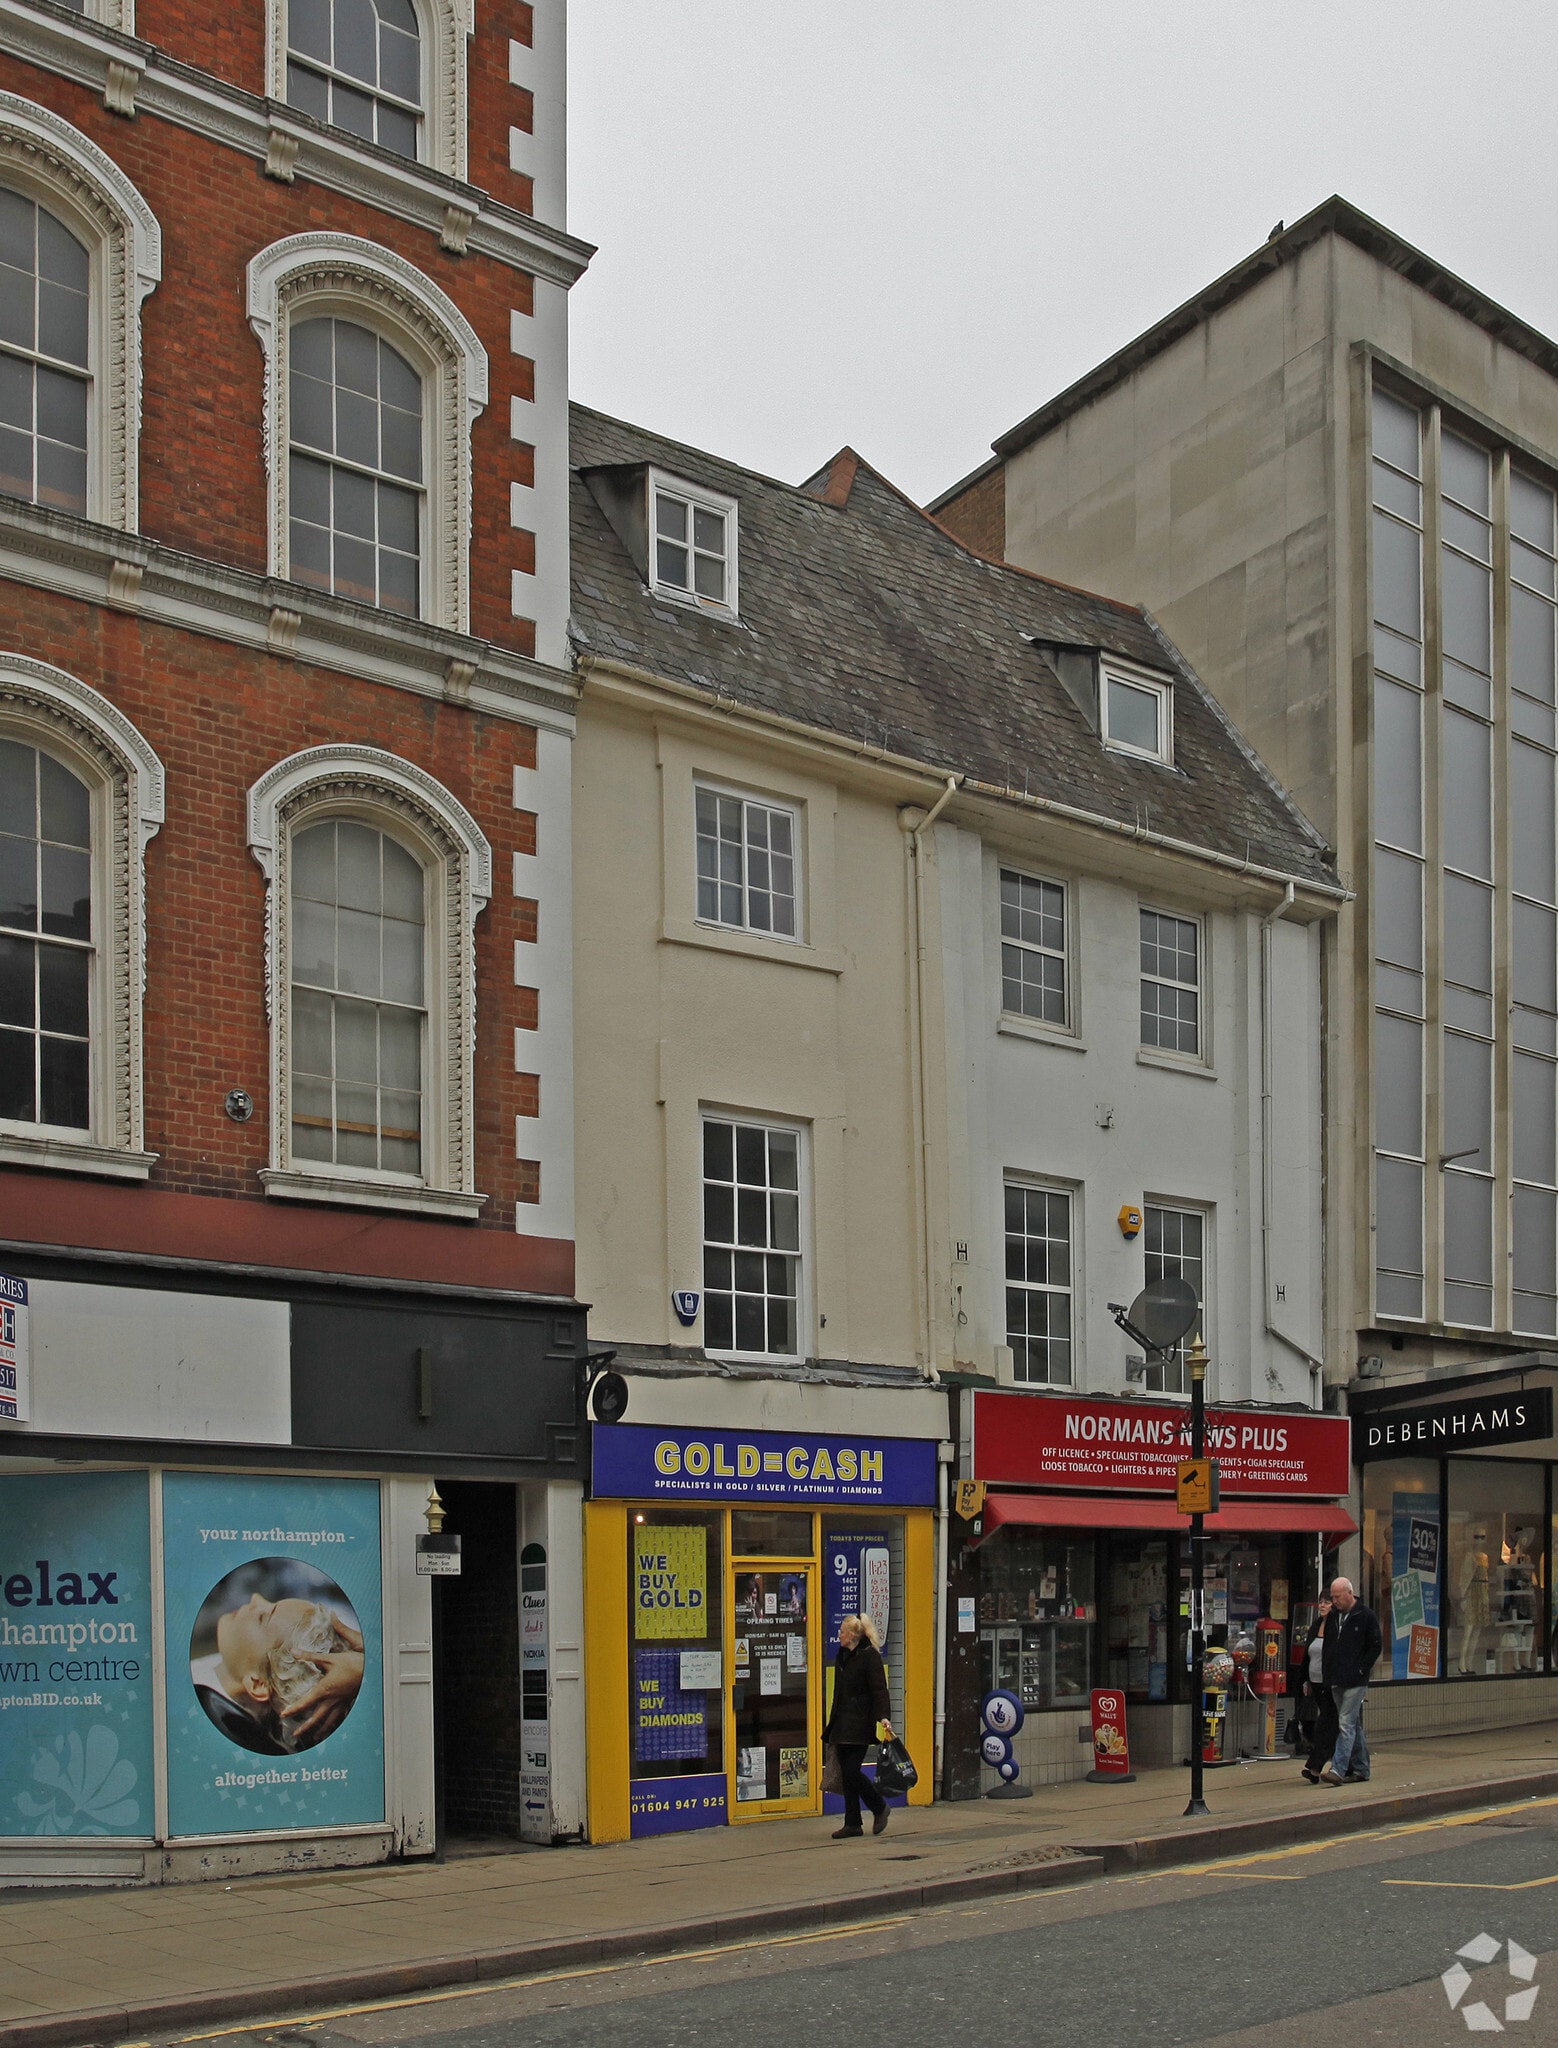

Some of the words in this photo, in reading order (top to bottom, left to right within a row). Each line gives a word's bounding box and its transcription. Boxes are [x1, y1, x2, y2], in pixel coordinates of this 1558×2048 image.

[1065, 1414, 1174, 1445] NORMANS
[1180, 1422, 1237, 1449] NWS
[1241, 1426, 1288, 1452] PLUS
[1368, 1406, 1526, 1446] DEBENHAMS
[654, 1440, 884, 1482] GOLD=CASH
[1042, 1447, 1057, 1457] OFF
[1058, 1449, 1090, 1459] LICENCE
[1096, 1450, 1139, 1462] SPECIALIST
[1247, 1458, 1267, 1468] CIGAR
[1268, 1459, 1305, 1470] SPECIALIST
[1041, 1461, 1067, 1471] LOOSE
[1068, 1462, 1103, 1473] TOBACCO
[1111, 1465, 1147, 1475] LIGHTERS
[1148, 1467, 1155, 1475] &
[1155, 1467, 1177, 1477] PIPES
[1219, 1470, 1242, 1480] ONERY
[1248, 1472, 1285, 1481] GREETINGS
[1286, 1472, 1308, 1482] CARDS
[654, 1480, 711, 1490] SPECIALISTS
[713, 1482, 723, 1490] IN
[726, 1482, 748, 1491] GOLD
[756, 1484, 786, 1492] SILVER
[793, 1485, 834, 1494] PLATINUM
[842, 1487, 882, 1495] DIAMONDS
[199, 1528, 238, 1544] your
[232, 1527, 346, 1546] northampton
[639, 1555, 667, 1571] WE
[833, 1554, 847, 1576] 9
[847, 1567, 858, 1576] CT
[0, 1560, 118, 1607] elax
[639, 1573, 677, 1589] BUY
[639, 1589, 703, 1609] GOLD
[0, 1617, 138, 1653] hampton
[523, 1649, 546, 1658] NOKIA
[49, 1655, 140, 1682] centre
[639, 1680, 660, 1693] WE
[639, 1696, 666, 1710] BUY
[639, 1712, 704, 1728] DIAMONDS
[523, 1725, 547, 1736] encore
[985, 1742, 1001, 1752] Play
[985, 1749, 1001, 1757] here
[215, 1769, 298, 1789] altogether
[301, 1767, 348, 1782] better
[520, 1775, 549, 1786] WALLPAPERS
[521, 1787, 532, 1797] AND
[532, 1787, 548, 1798] PAINTS
[631, 1801, 670, 1813] 01604
[675, 1799, 697, 1810] 947
[703, 1796, 725, 1807] 925
